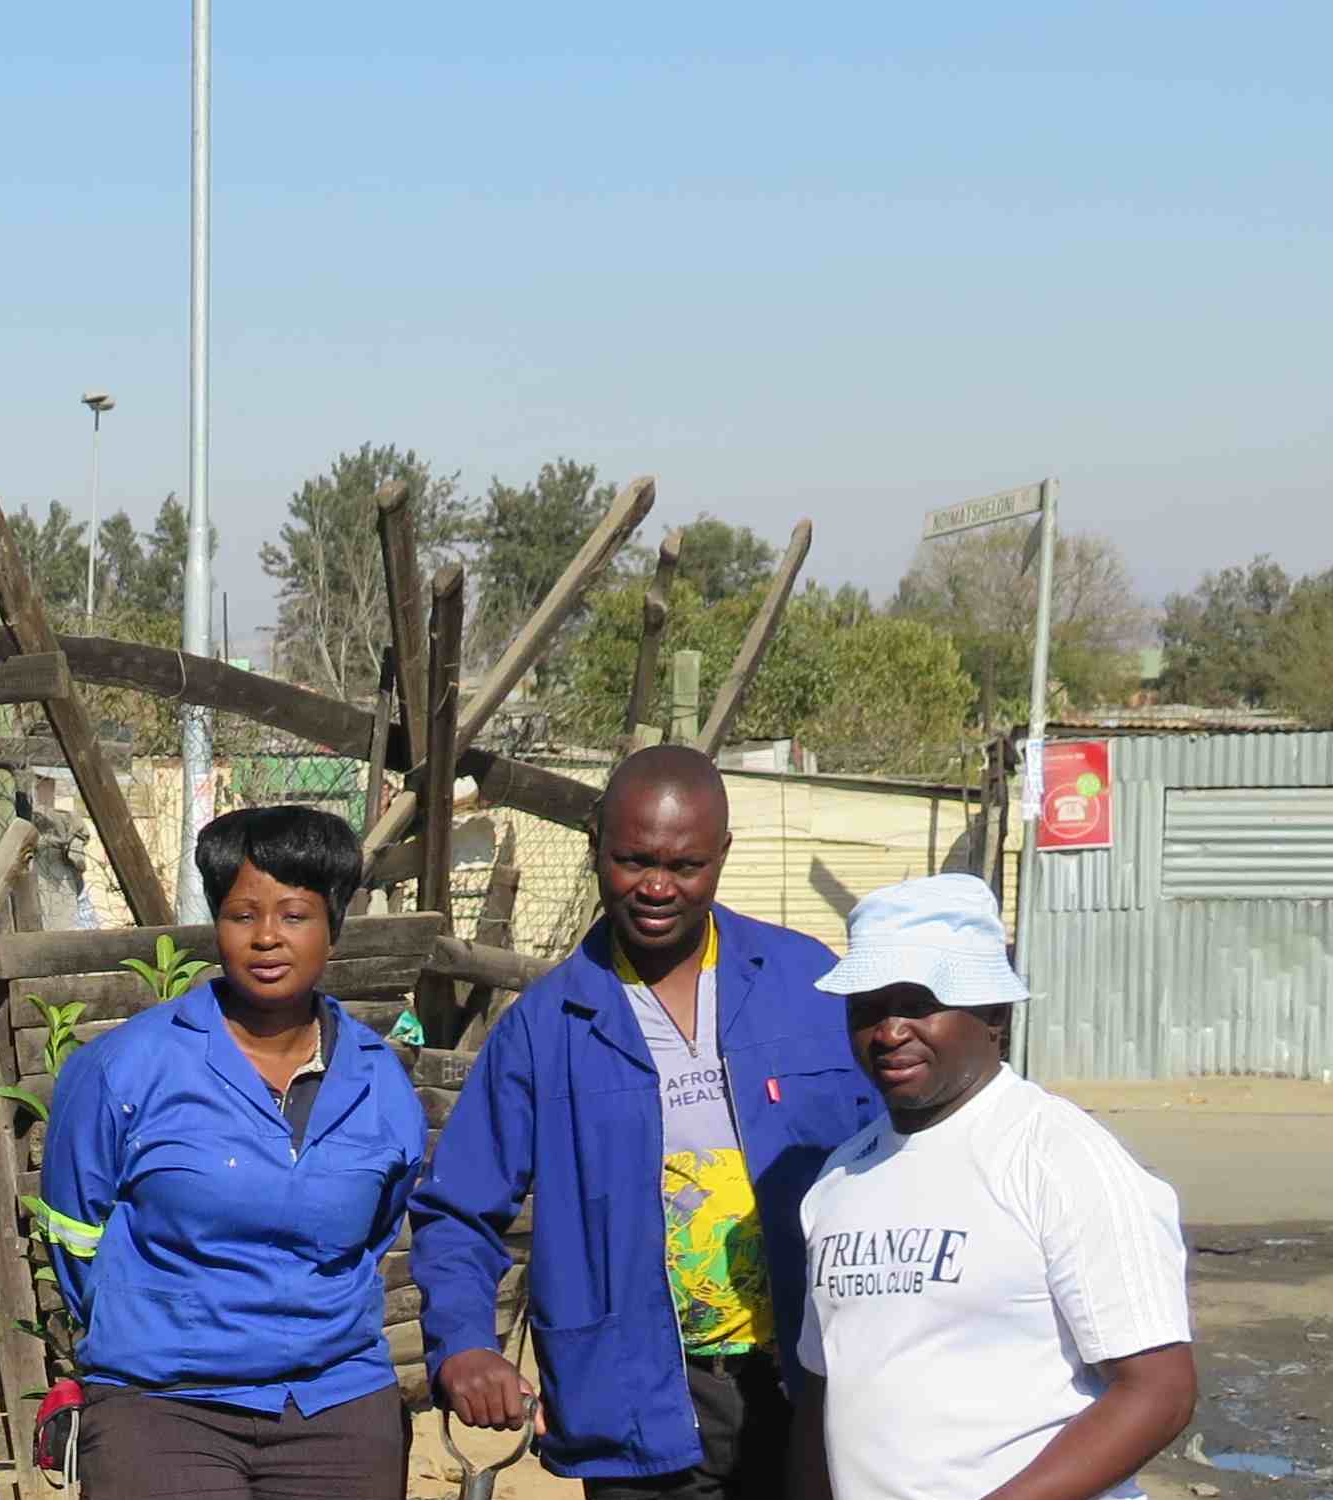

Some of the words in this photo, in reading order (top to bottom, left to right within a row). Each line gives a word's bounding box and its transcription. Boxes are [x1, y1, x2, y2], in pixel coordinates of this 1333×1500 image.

[814, 1228, 967, 1288] TRIANGLE
[828, 1273, 882, 1297] FUTBOL
[886, 1271, 924, 1294] CLUB
